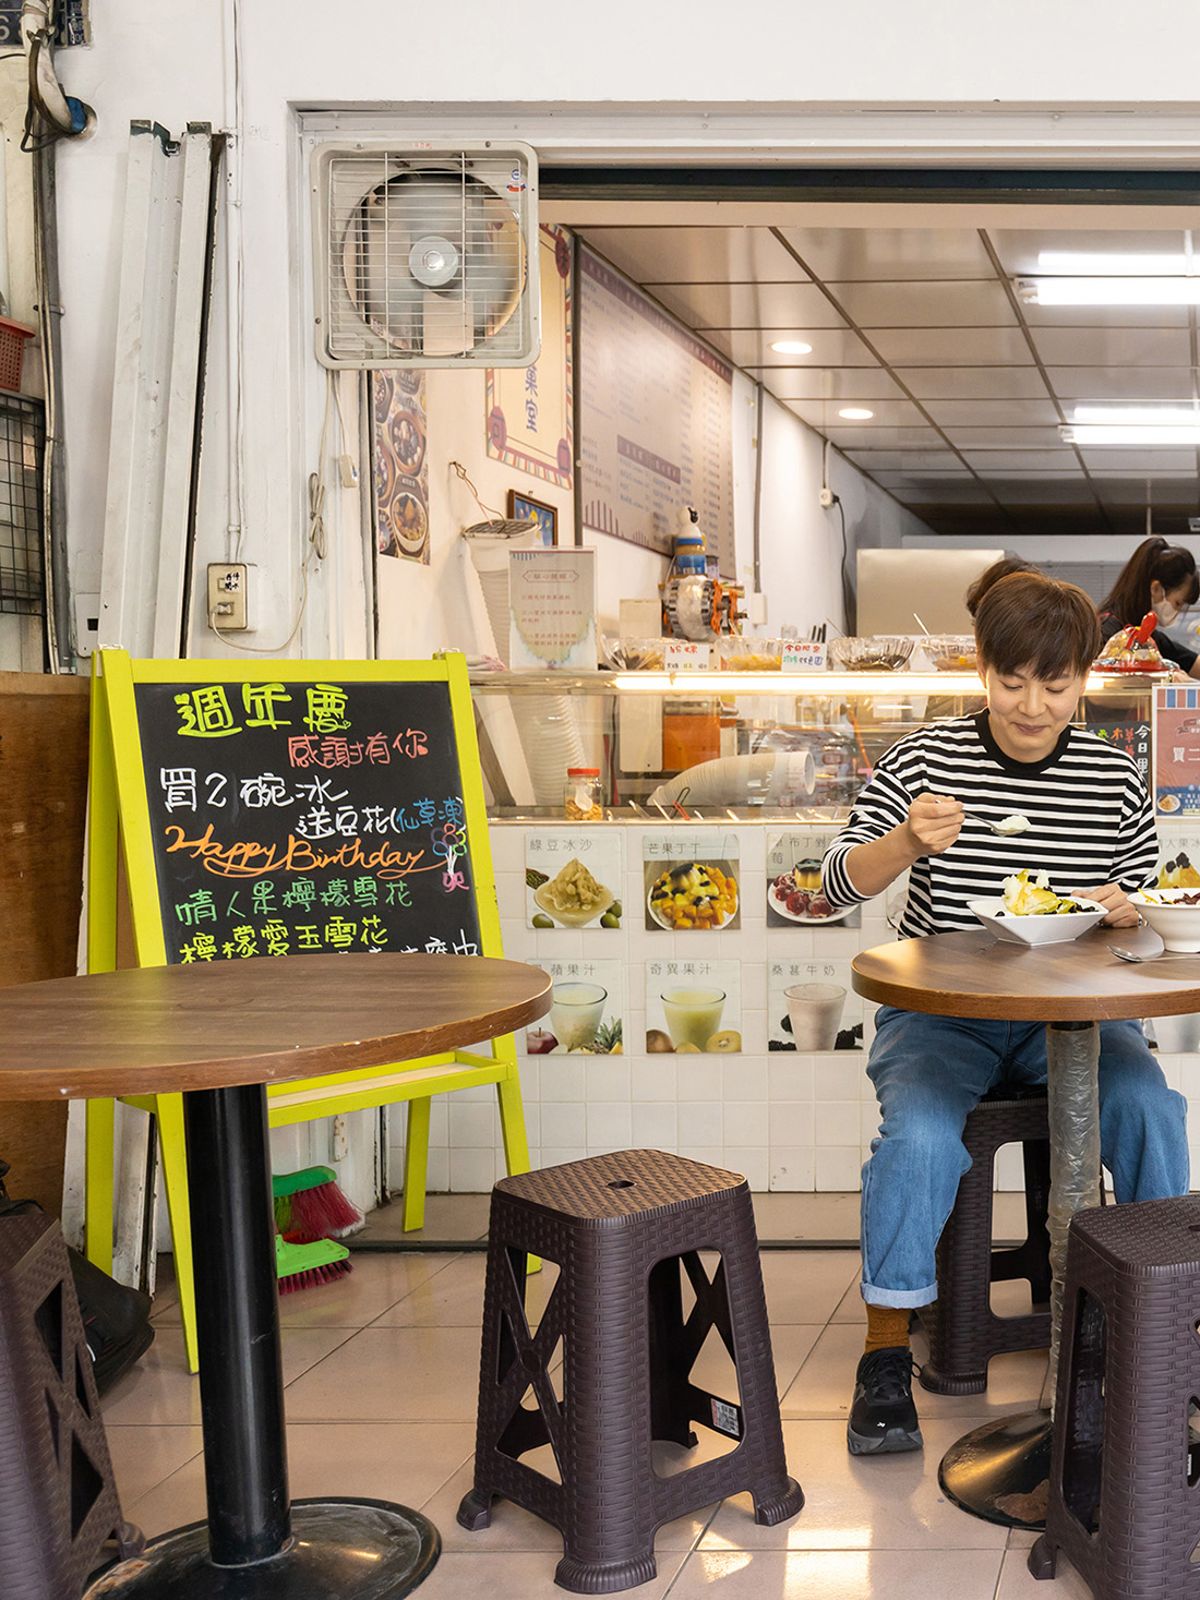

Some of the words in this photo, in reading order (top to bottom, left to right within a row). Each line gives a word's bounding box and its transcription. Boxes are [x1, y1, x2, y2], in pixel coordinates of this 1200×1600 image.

[174, 683, 351, 738] 週年慶
[287, 727, 429, 769] 感謝有你
[160, 767, 349, 813] 買2碗冰
[164, 822, 290, 879] Happy
[284, 834, 449, 880] Birthday
[529, 838, 593, 852] 綠豆冰沙
[174, 876, 414, 926] 情人果檸檬雪花
[179, 914, 388, 965] 檸檬愛玉雪花
[533, 962, 597, 977] 蘋果汁
[650, 962, 712, 977] 奇異果汁
